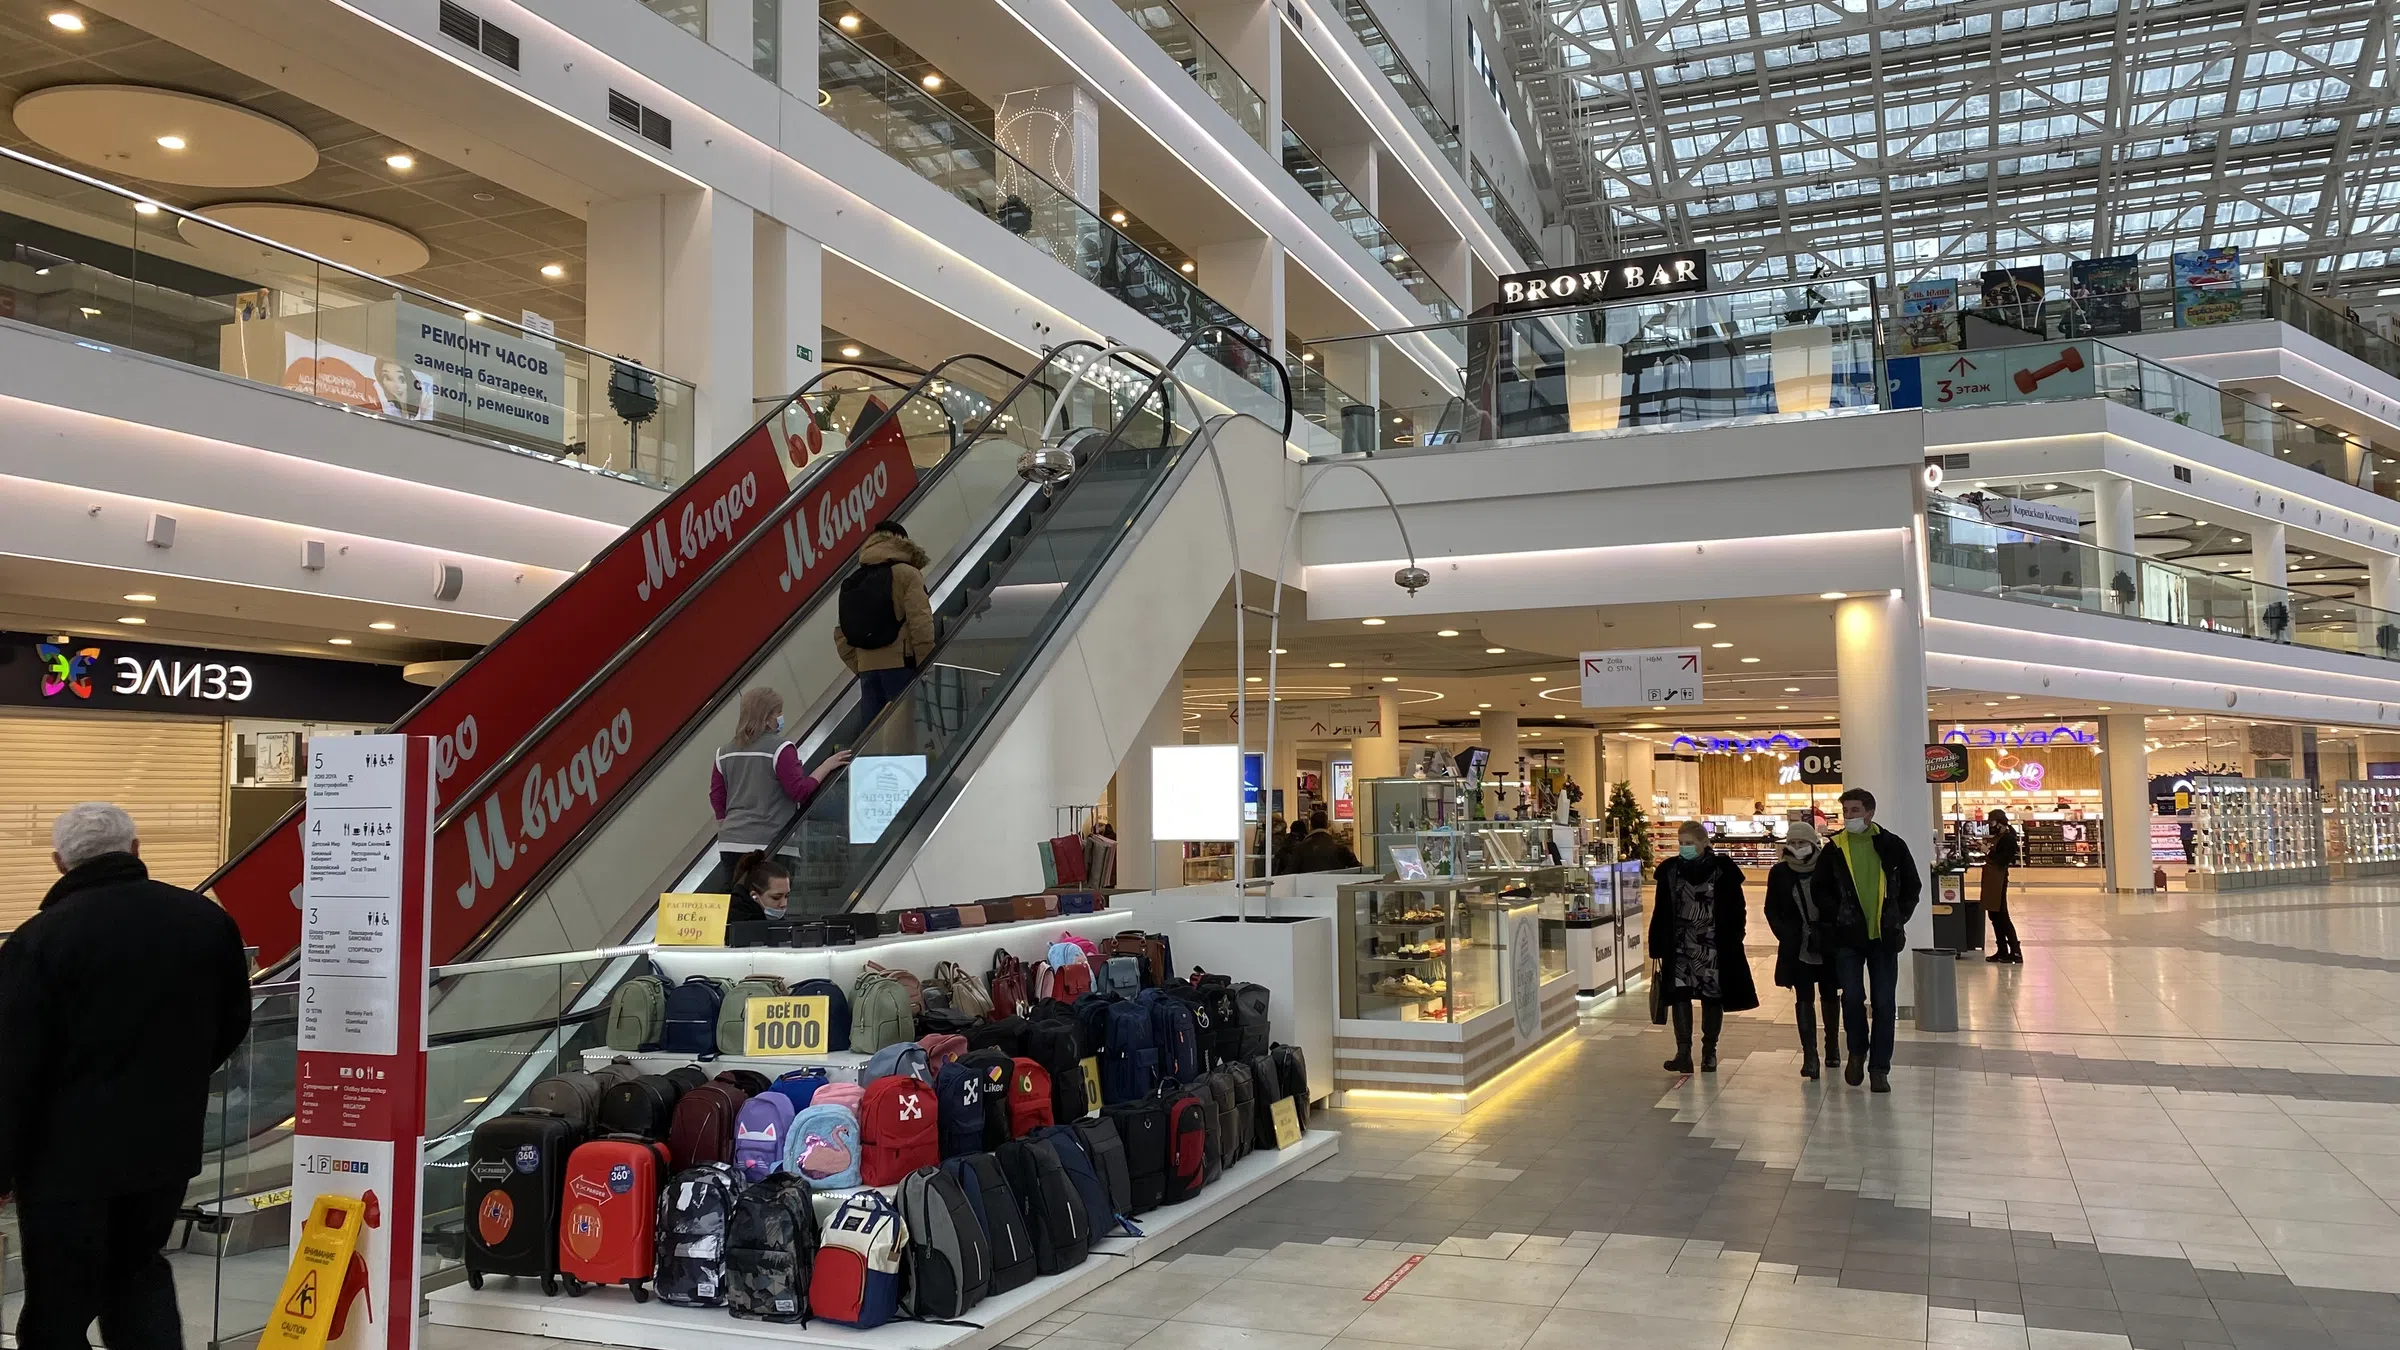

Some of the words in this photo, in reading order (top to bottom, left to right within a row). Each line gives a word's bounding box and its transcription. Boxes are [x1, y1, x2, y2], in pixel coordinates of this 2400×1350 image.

[1504, 269, 1610, 304] BROW
[1623, 260, 1699, 289] BAR
[421, 323, 491, 358] РЕМОНТ
[495, 347, 549, 375] ЧАСОВ
[414, 352, 473, 380] замена
[478, 368, 548, 403] батареек,
[1936, 379, 1954, 403] 3
[1956, 382, 1991, 395] этаж
[413, 379, 472, 411] стекол,
[476, 395, 550, 425] ремешков
[2013, 504, 2044, 520] Корейская
[2044, 510, 2078, 526] Косметика
[779, 460, 888, 593] М.видео
[637, 471, 757, 602] М.видео
[112, 656, 253, 701] ЭЛИЗЭ
[314, 752, 323, 769] 5
[456, 708, 633, 909] М.видео
[312, 819, 321, 836] 4
[666, 902, 722, 911] РАСПРОДАЖА
[309, 908, 318, 925] 3
[677, 927, 703, 940] 499р
[306, 986, 315, 1004] 2
[766, 1002, 791, 1019] ВСЁ
[793, 1003, 810, 1019] ПО
[754, 1020, 821, 1050] 1000
[303, 1061, 312, 1079] 1
[983, 1083, 1004, 1093] Likee
[300, 1154, 315, 1173] -1
[343, 1162, 349, 1170] D
[352, 1163, 358, 1171] E
[361, 1163, 367, 1171] F
[613, 1164, 626, 1172] NEW
[281, 1321, 307, 1336] CAUTION
